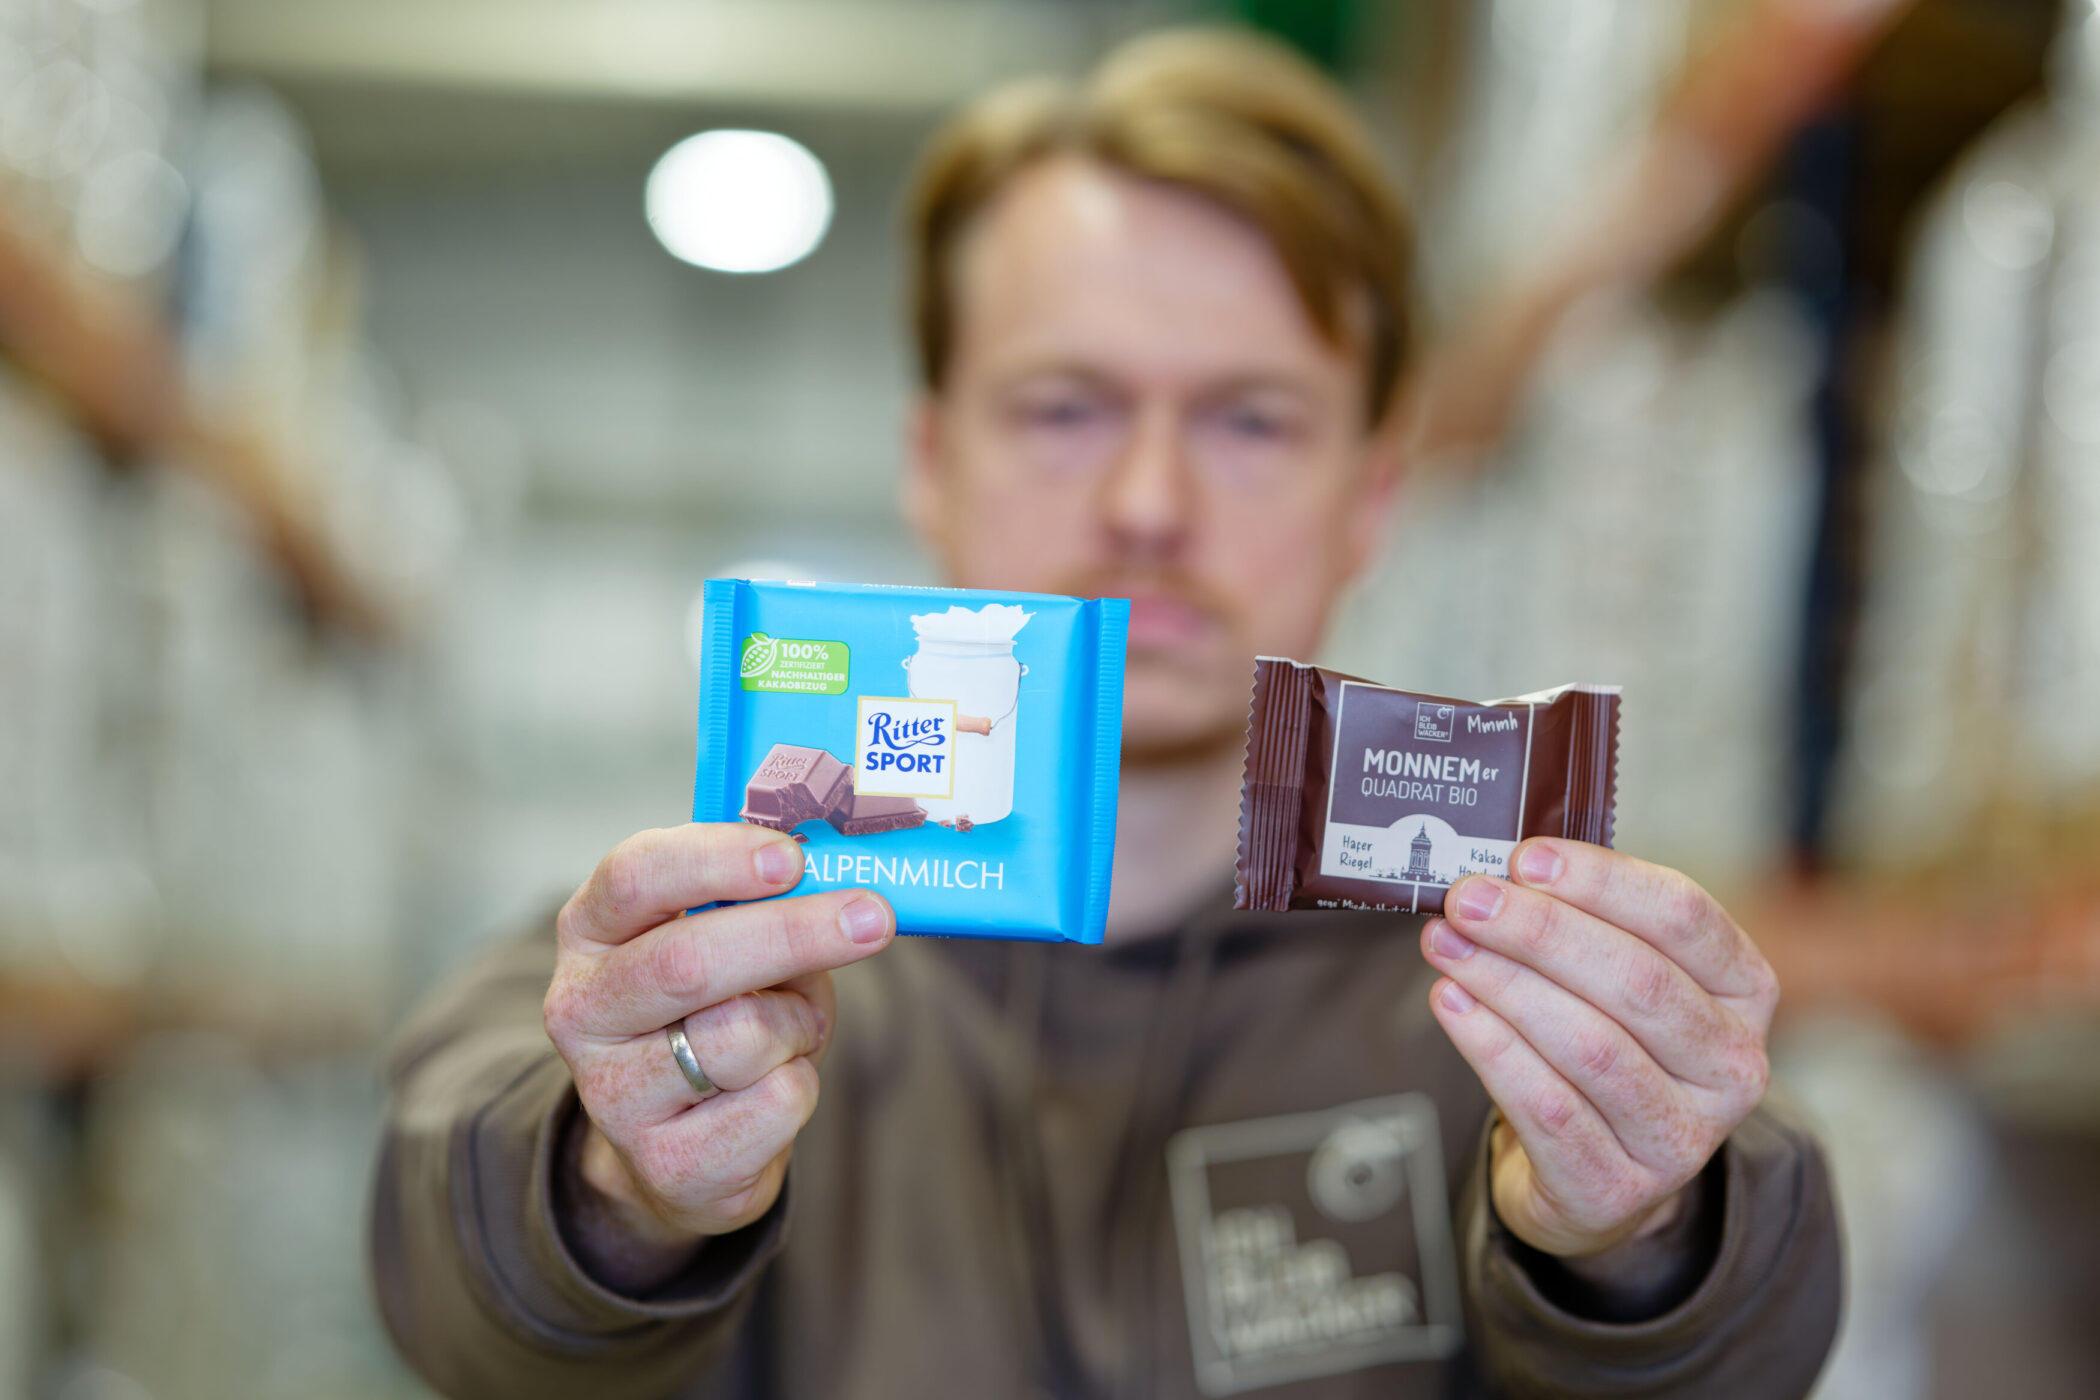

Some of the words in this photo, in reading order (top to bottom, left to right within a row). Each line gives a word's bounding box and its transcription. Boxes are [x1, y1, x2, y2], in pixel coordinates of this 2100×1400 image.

[781, 643, 829, 660] 100%
[758, 680, 827, 691] KAKAOBEZUG
[771, 670, 846, 682] NACHHALTIGER
[867, 712, 946, 751] Ritter
[1467, 711, 1518, 734] Mmmh
[865, 751, 946, 774] SPORT
[1361, 777, 1445, 802] QUADRAT
[1448, 785, 1478, 807] BIO
[1343, 834, 1373, 853] Hafer
[1340, 851, 1373, 871] Riegel
[1470, 848, 1503, 865] Kakao
[804, 852, 1005, 891] ALPENMILCH
